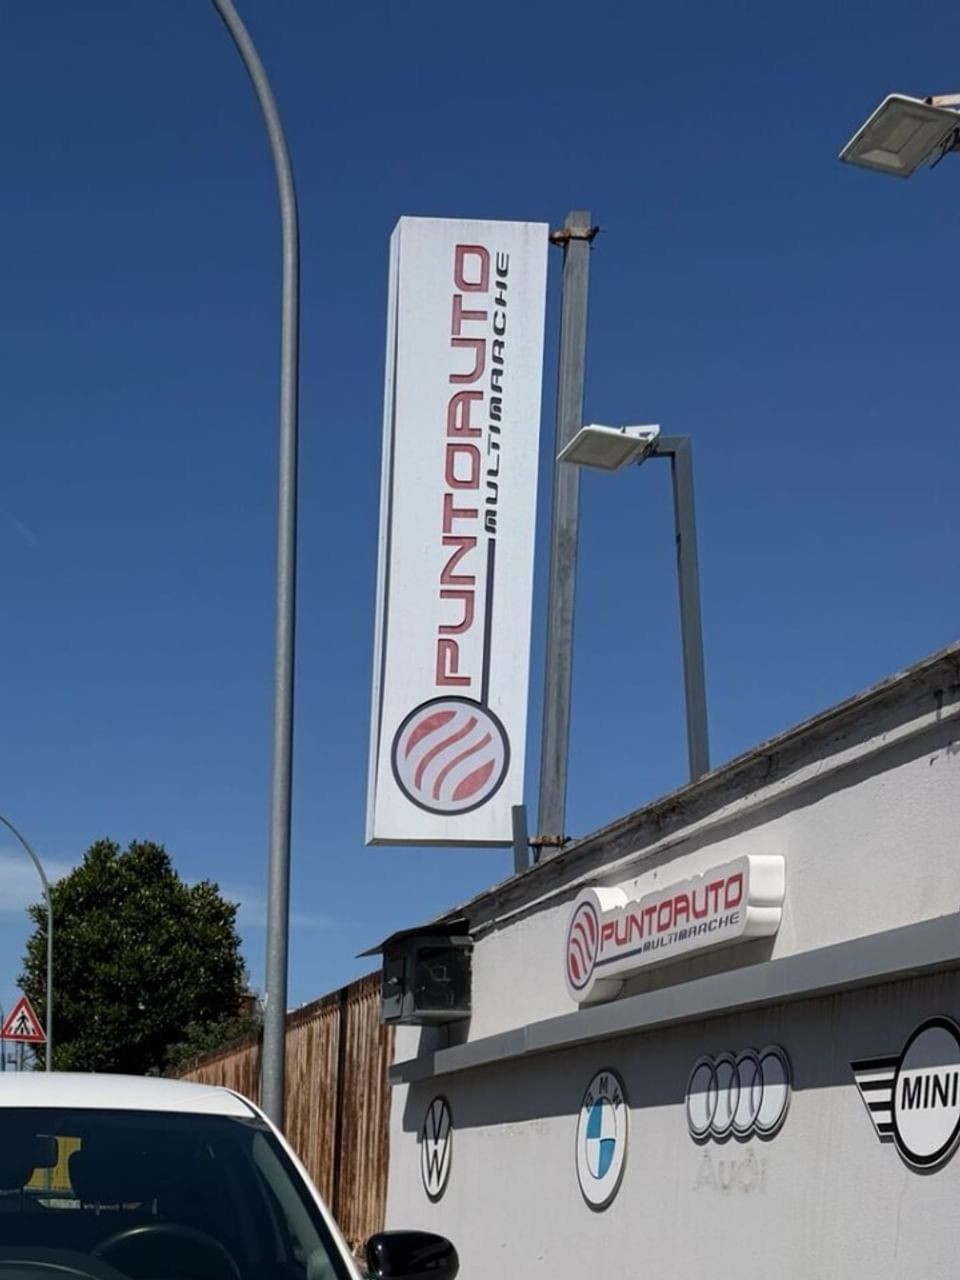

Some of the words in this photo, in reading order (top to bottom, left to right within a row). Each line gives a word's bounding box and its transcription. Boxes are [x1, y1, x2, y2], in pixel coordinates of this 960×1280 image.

[485, 251, 509, 534] MULTIMARCHE
[436, 244, 491, 686] PUNTOAUTO
[600, 872, 743, 952] PUNTOAUTO
[643, 911, 740, 953] MULTIMARCHE
[901, 1072, 958, 1110] MINI
